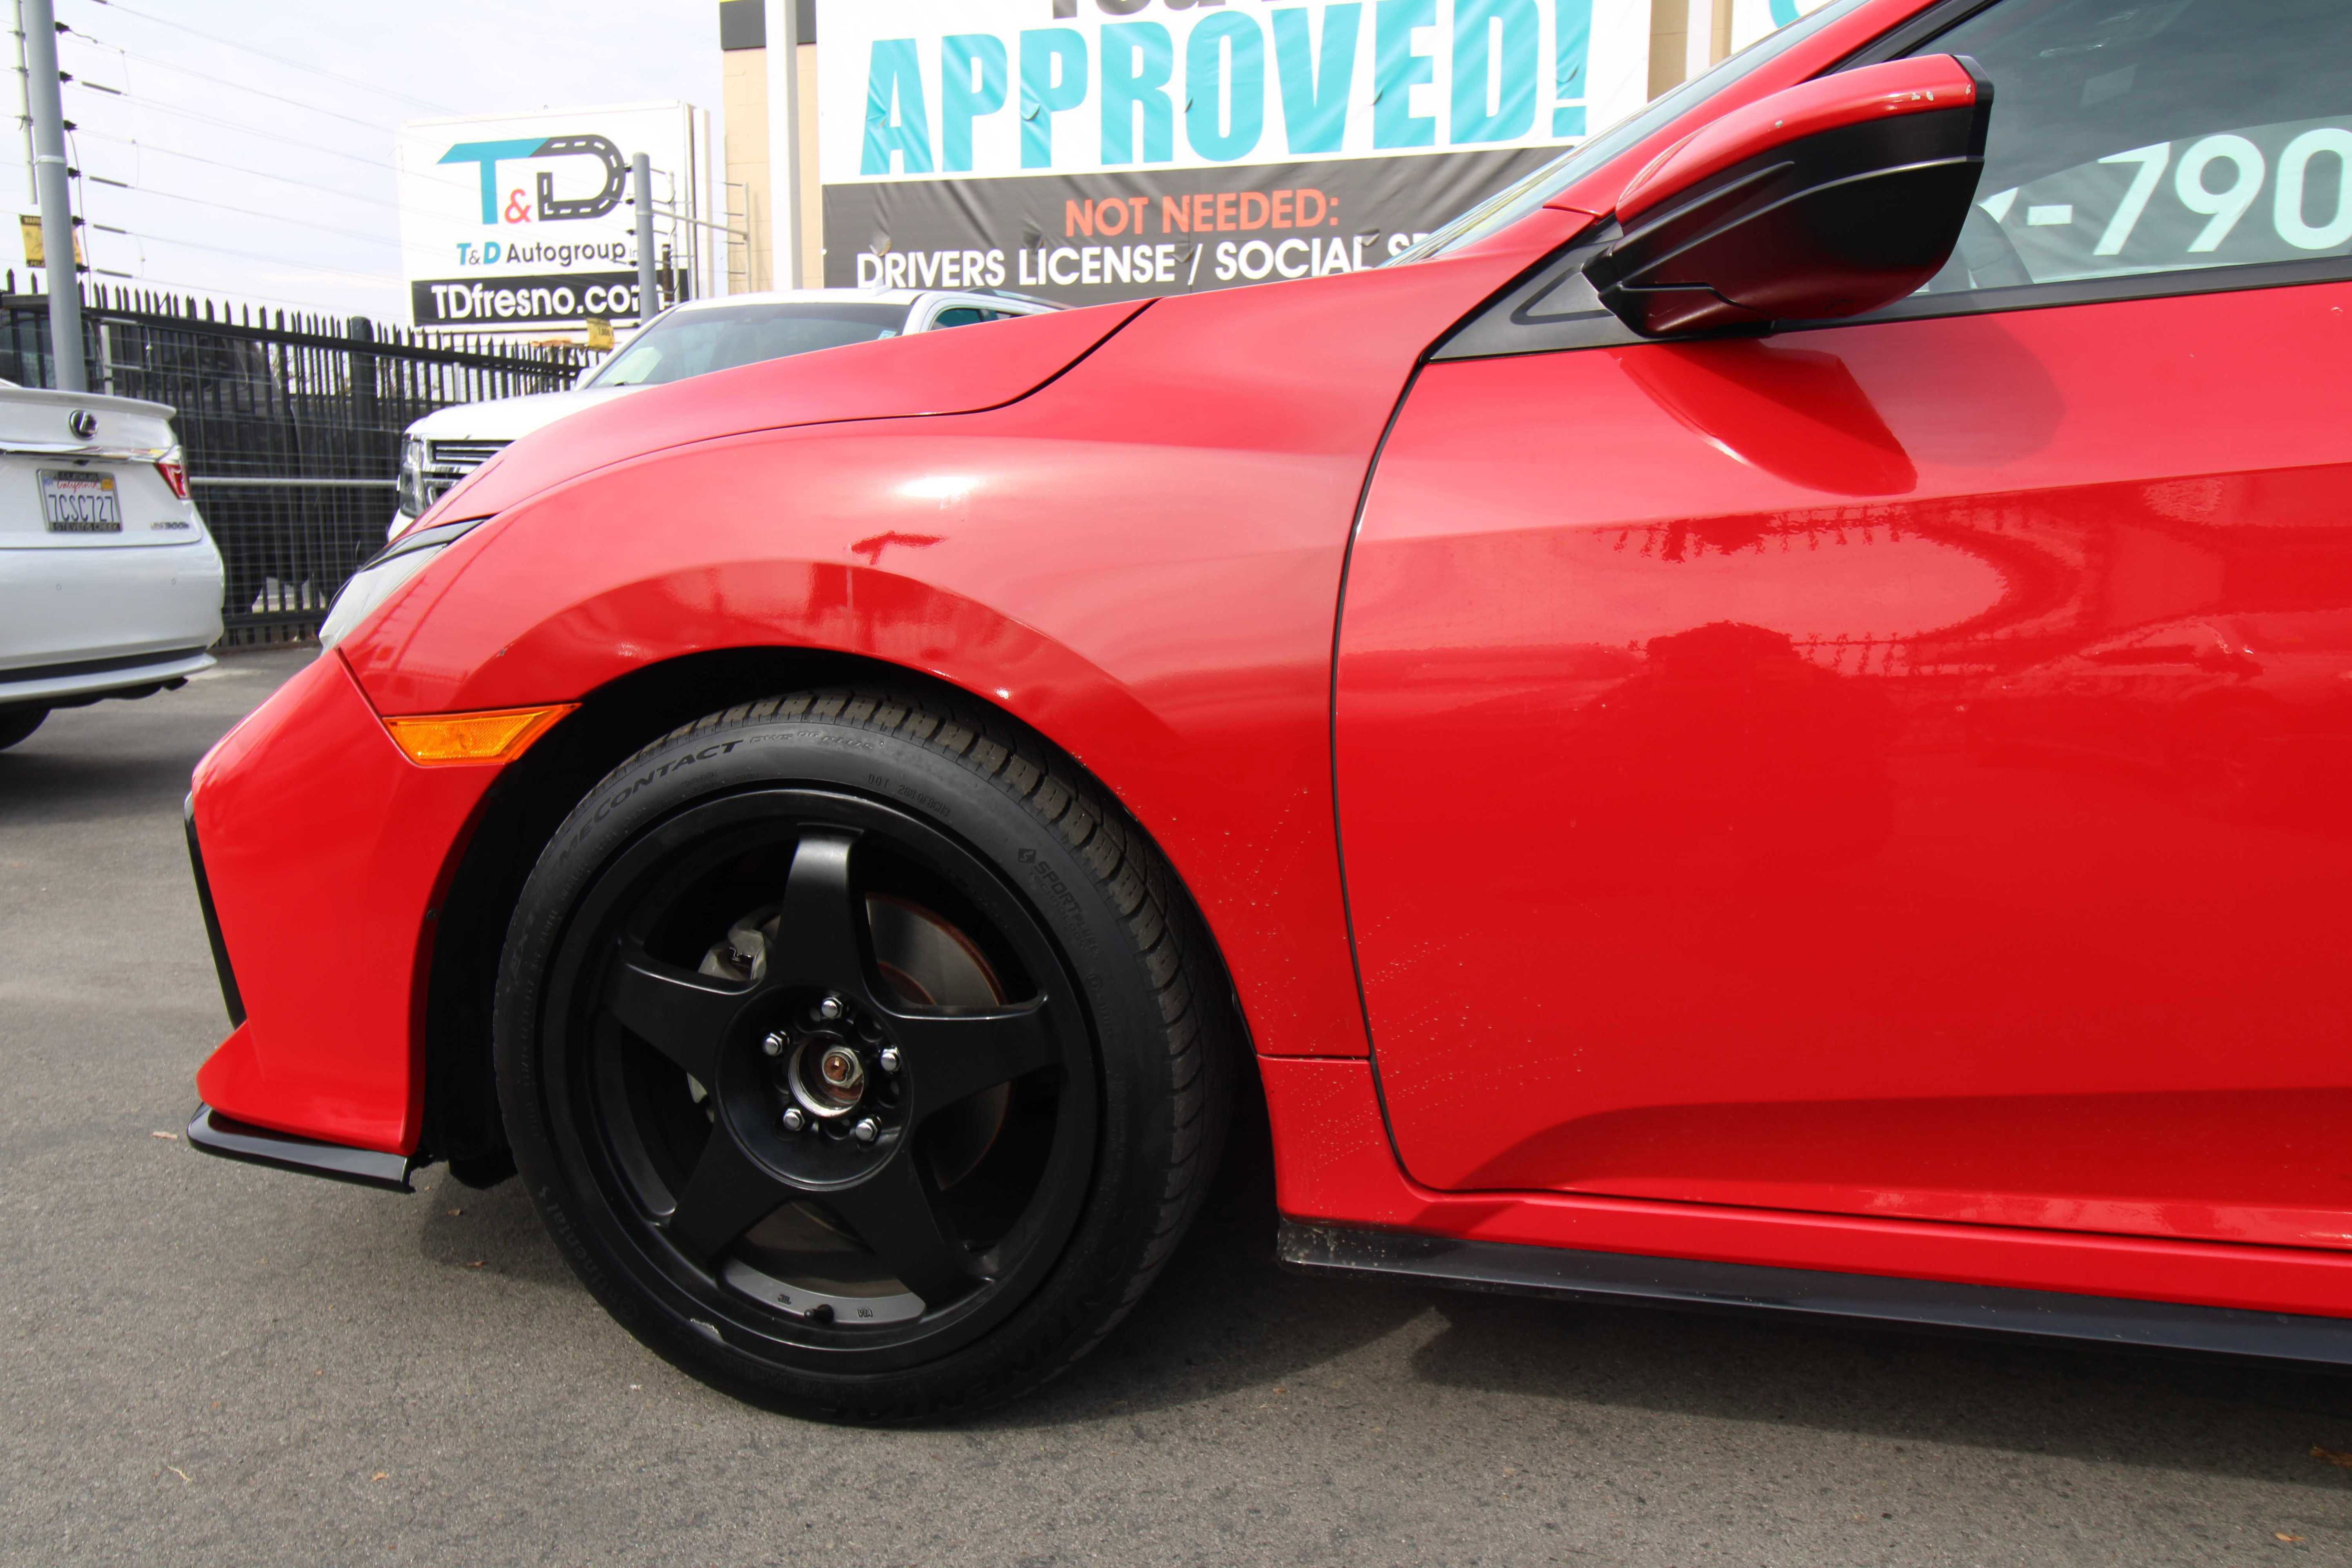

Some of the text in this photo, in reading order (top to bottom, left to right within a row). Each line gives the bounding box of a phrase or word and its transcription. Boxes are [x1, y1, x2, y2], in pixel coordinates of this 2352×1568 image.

[860, 0, 1593, 175] APPROVED!
[1066, 188, 1339, 238] NOT NEEDED:
[457, 242, 501, 265] T&D
[506, 242, 626, 266] Autogroup
[856, 249, 1006, 288] DRIVERS
[1019, 244, 1175, 285] LICENSE
[1188, 244, 1203, 285] /
[1215, 234, 1373, 281] SOCIAL
[431, 283, 666, 319] TDfresno.com
[48, 494, 114, 522] 7CSC727
